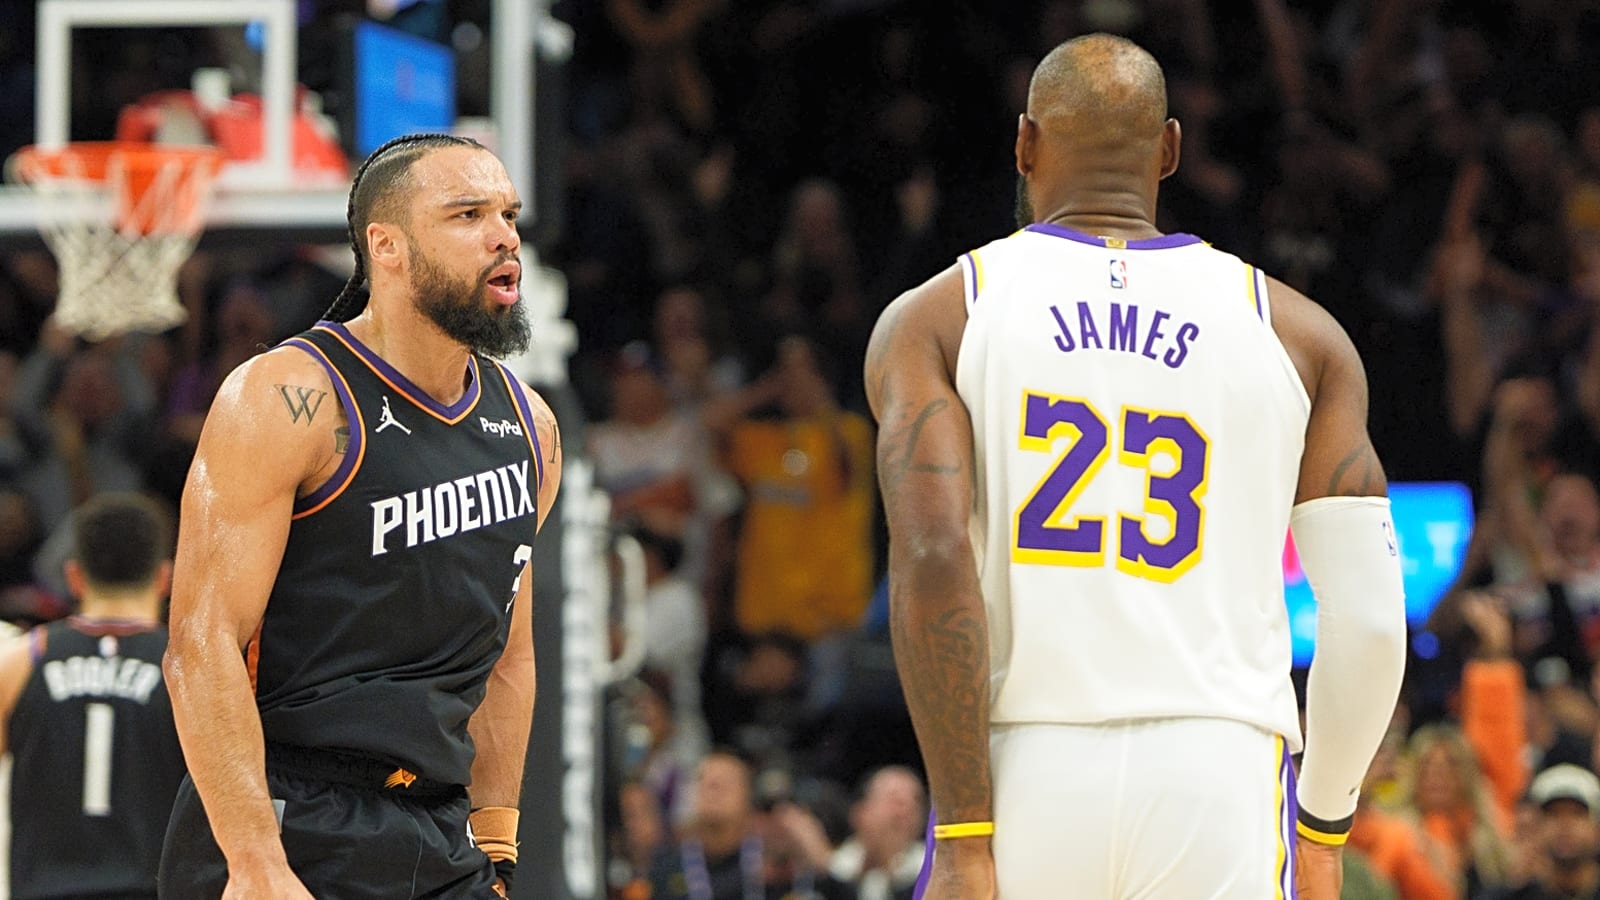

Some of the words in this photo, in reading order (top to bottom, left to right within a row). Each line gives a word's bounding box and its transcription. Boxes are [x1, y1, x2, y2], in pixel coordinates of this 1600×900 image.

[1049, 301, 1200, 369] JAMES
[479, 416, 523, 437] PayPal
[370, 459, 535, 557] PHOENIX
[1010, 387, 1213, 584] 23
[82, 702, 115, 816] 1
